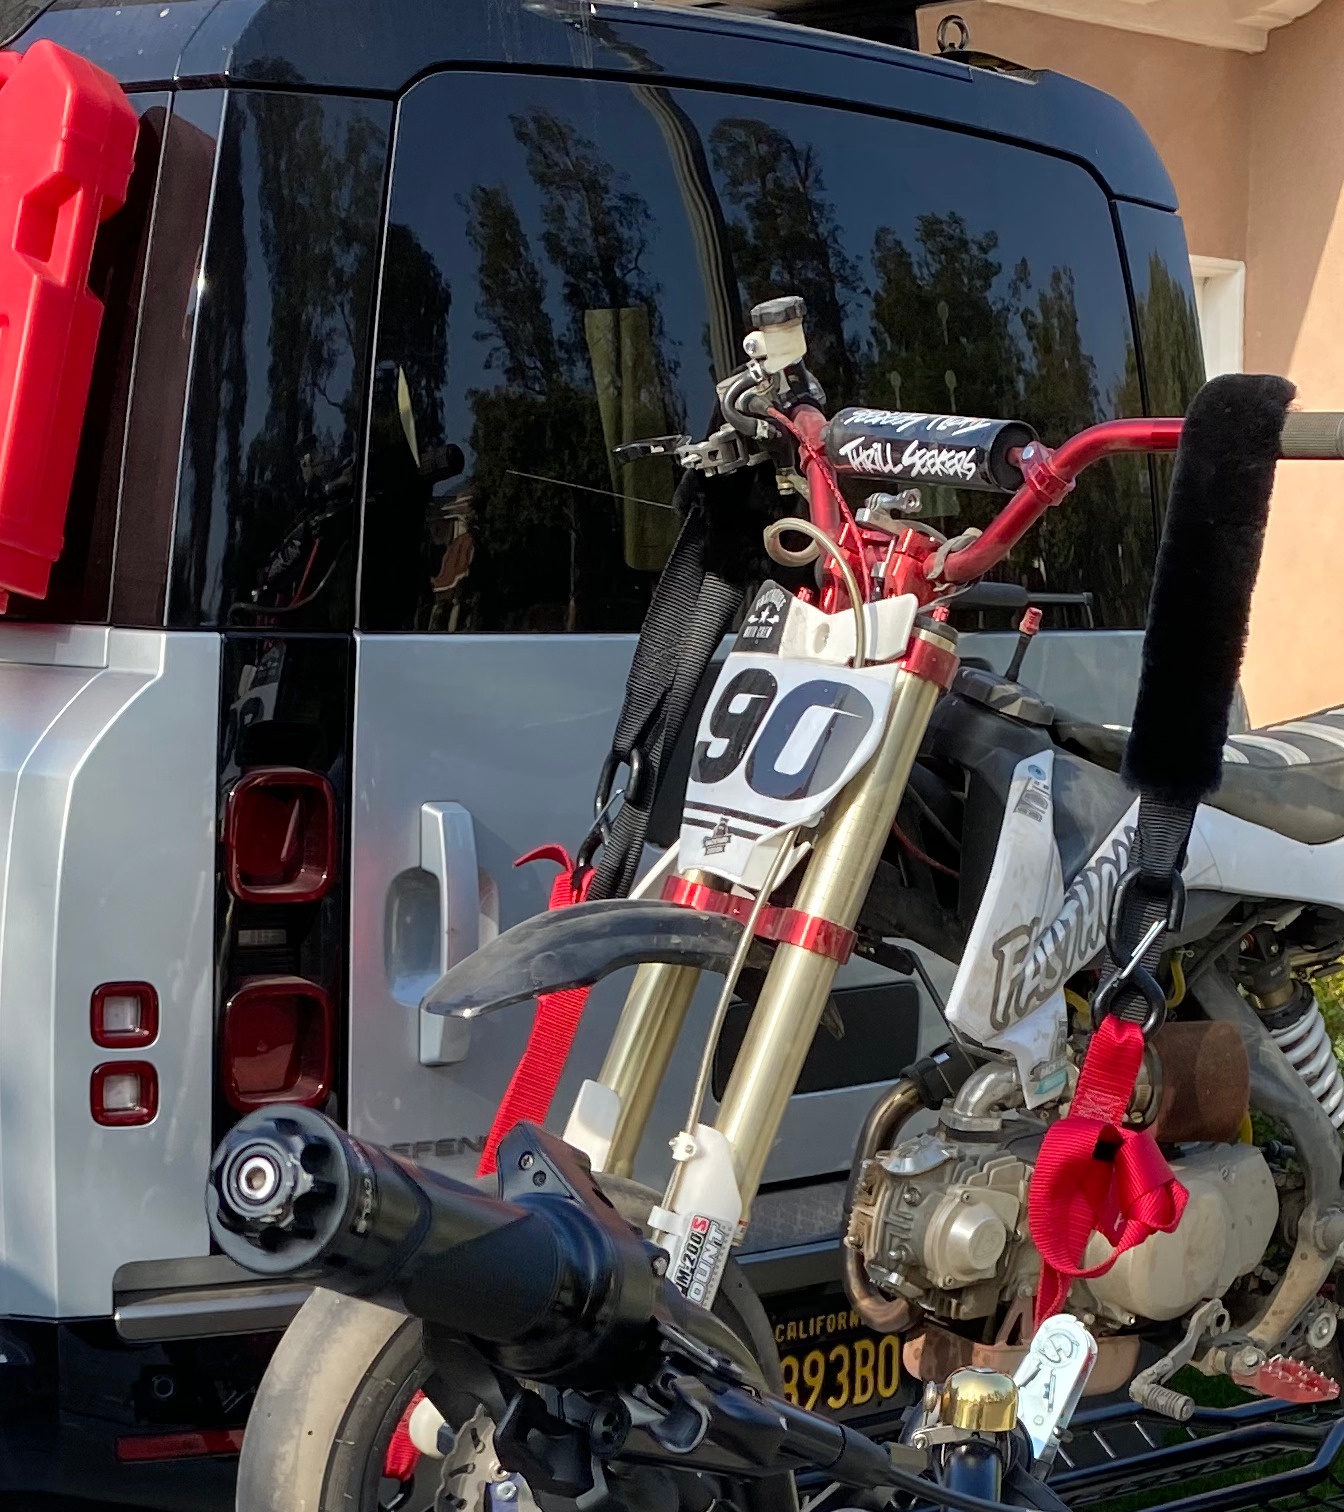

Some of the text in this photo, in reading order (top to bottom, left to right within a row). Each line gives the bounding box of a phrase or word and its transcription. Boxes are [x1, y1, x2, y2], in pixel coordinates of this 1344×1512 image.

[690, 667, 874, 802] 90
[688, 1219, 726, 1304] OUNT
[776, 1309, 861, 1343] CALIFORN
